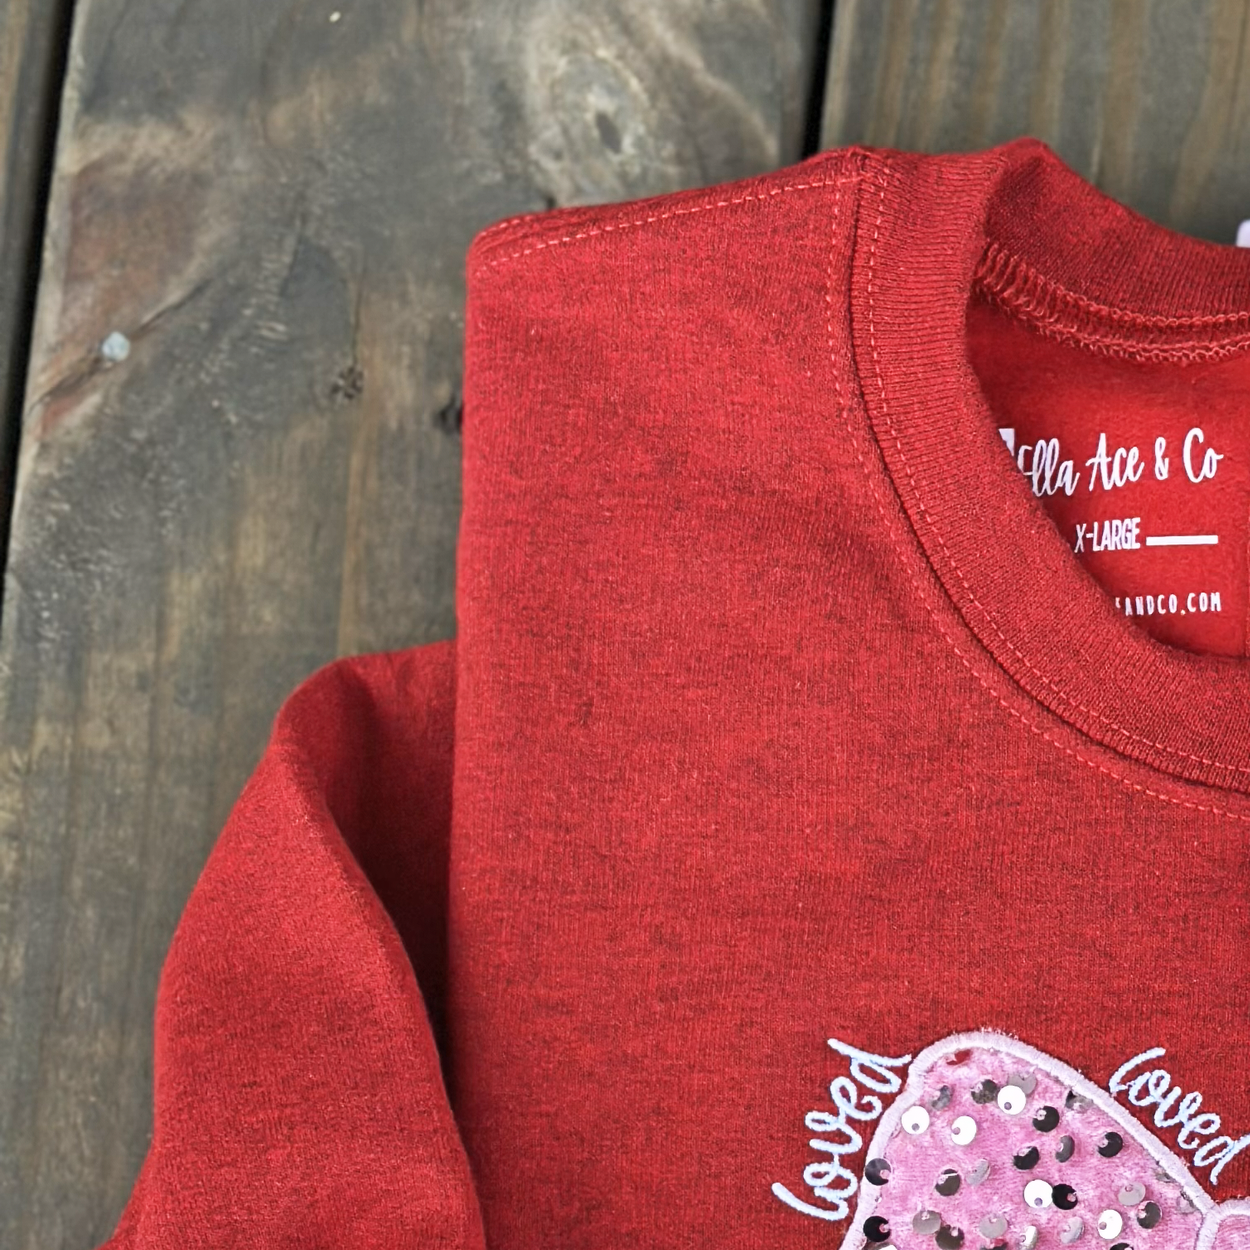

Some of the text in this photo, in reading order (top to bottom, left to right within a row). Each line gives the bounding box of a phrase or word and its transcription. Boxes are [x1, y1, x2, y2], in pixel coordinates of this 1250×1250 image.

[1085, 432, 1145, 491] Ace
[1154, 436, 1170, 480] &
[1183, 427, 1224, 483] Co
[1074, 517, 1141, 553] X-LARGE
[771, 1038, 912, 1220] loved
